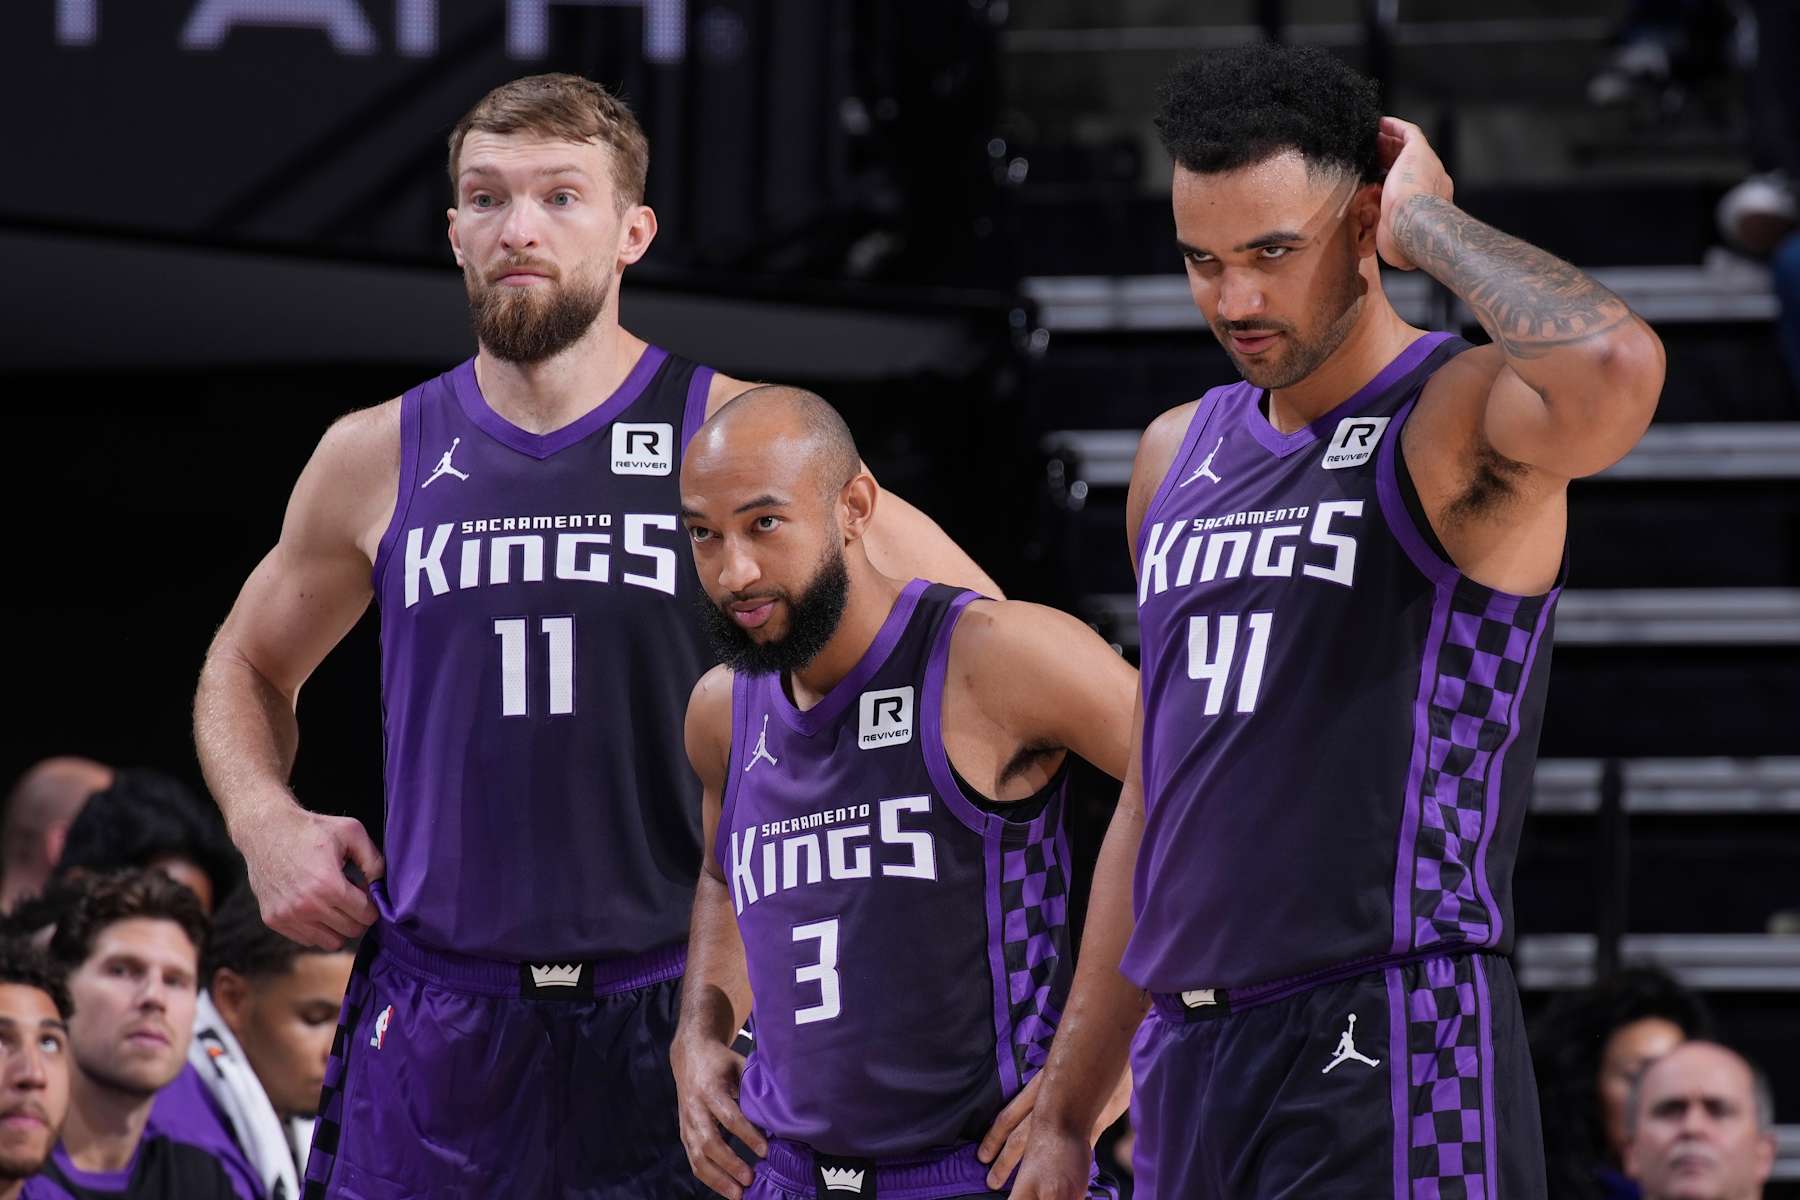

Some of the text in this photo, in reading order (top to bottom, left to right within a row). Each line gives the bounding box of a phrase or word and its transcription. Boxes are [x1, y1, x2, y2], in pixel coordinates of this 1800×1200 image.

[626, 431, 659, 455] R
[1341, 424, 1376, 448] R
[615, 461, 667, 469] REVIVER
[1327, 452, 1369, 462] REVIVER
[462, 514, 612, 534] SACRAMENTO
[1192, 506, 1310, 531] SACRAMENTO
[494, 617, 573, 717] 11
[1187, 612, 1273, 716] 41
[873, 696, 903, 726] R
[863, 729, 909, 742] REVIVER
[762, 804, 870, 837] SACRAMENTO
[792, 918, 841, 1025] 3
